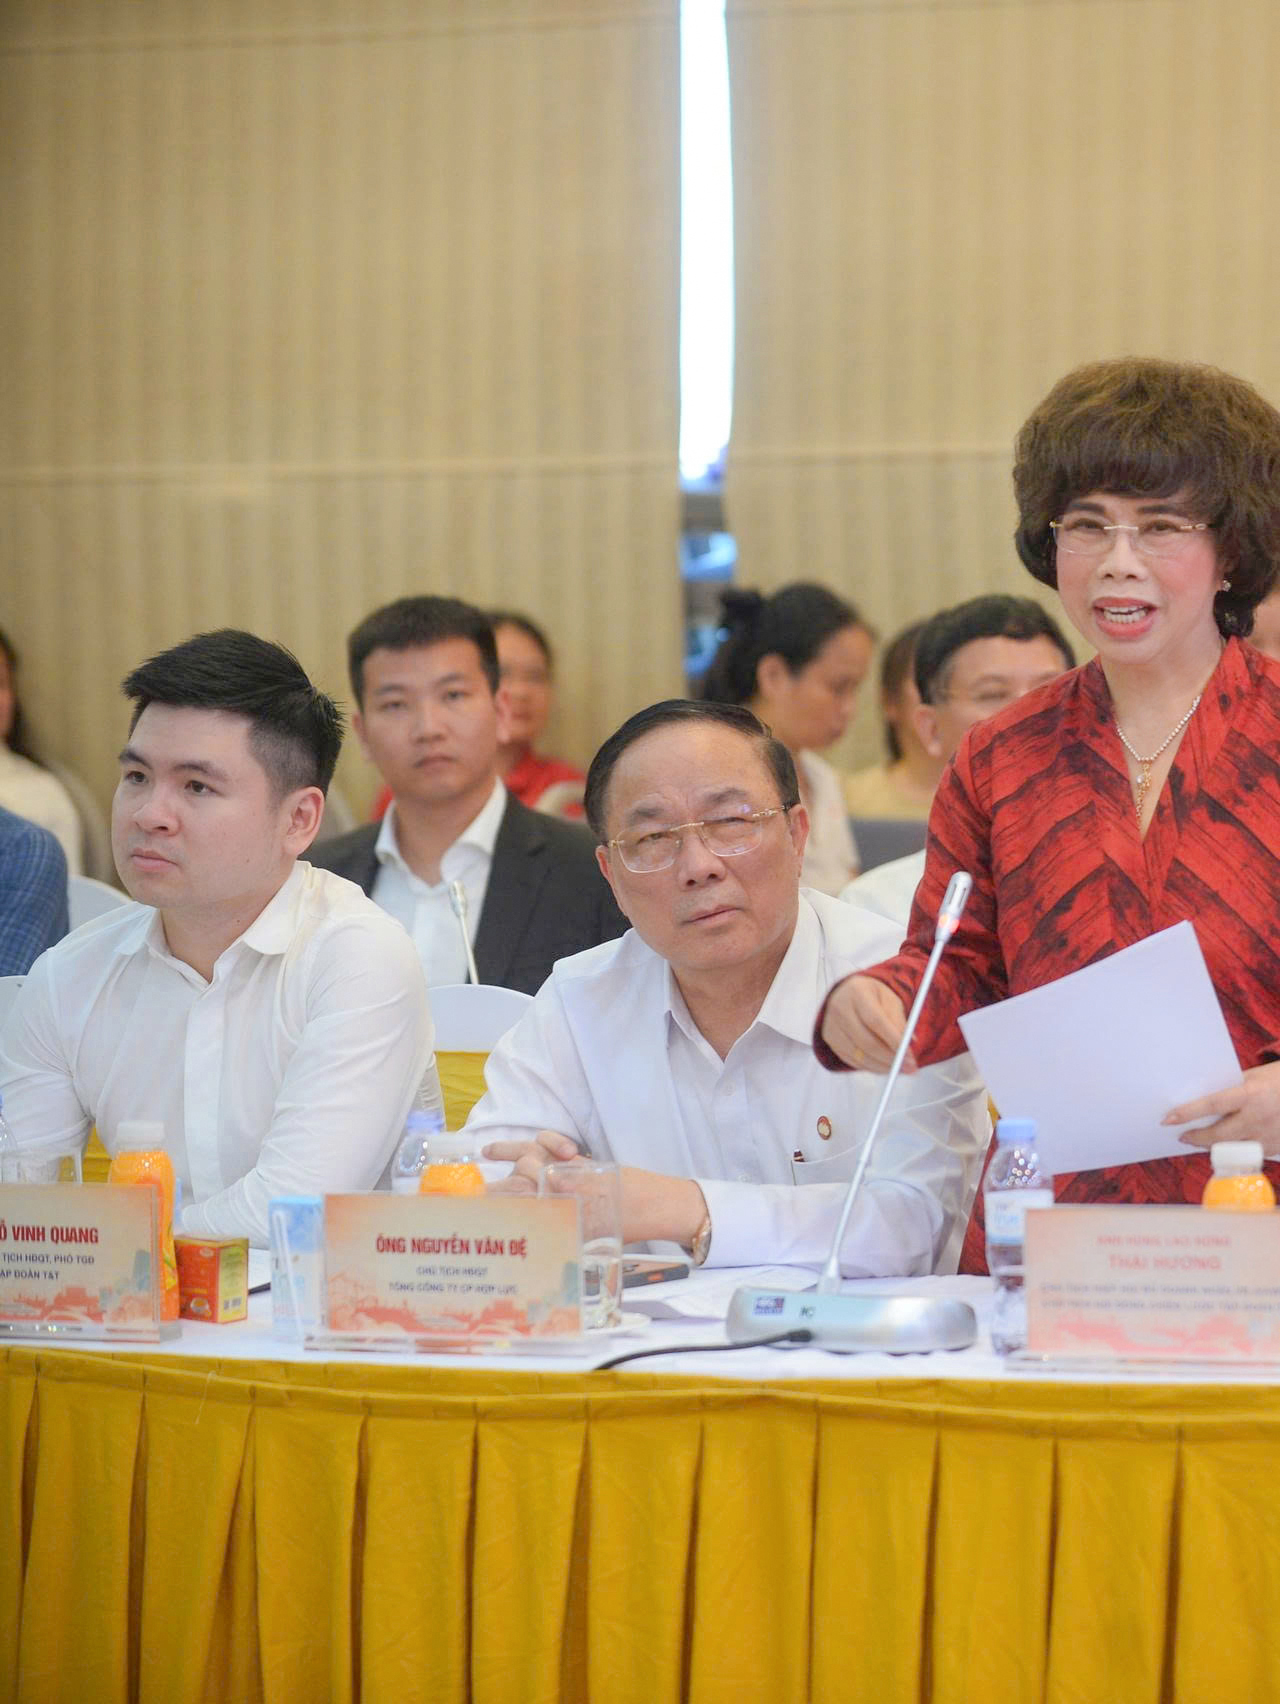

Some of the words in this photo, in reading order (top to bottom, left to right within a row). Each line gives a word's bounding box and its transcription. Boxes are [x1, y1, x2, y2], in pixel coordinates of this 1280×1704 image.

[12, 1226, 46, 1241] VINH
[51, 1226, 99, 1244] QUANG
[376, 1233, 406, 1253] ÔNG
[43, 1270, 59, 1280] T&T
